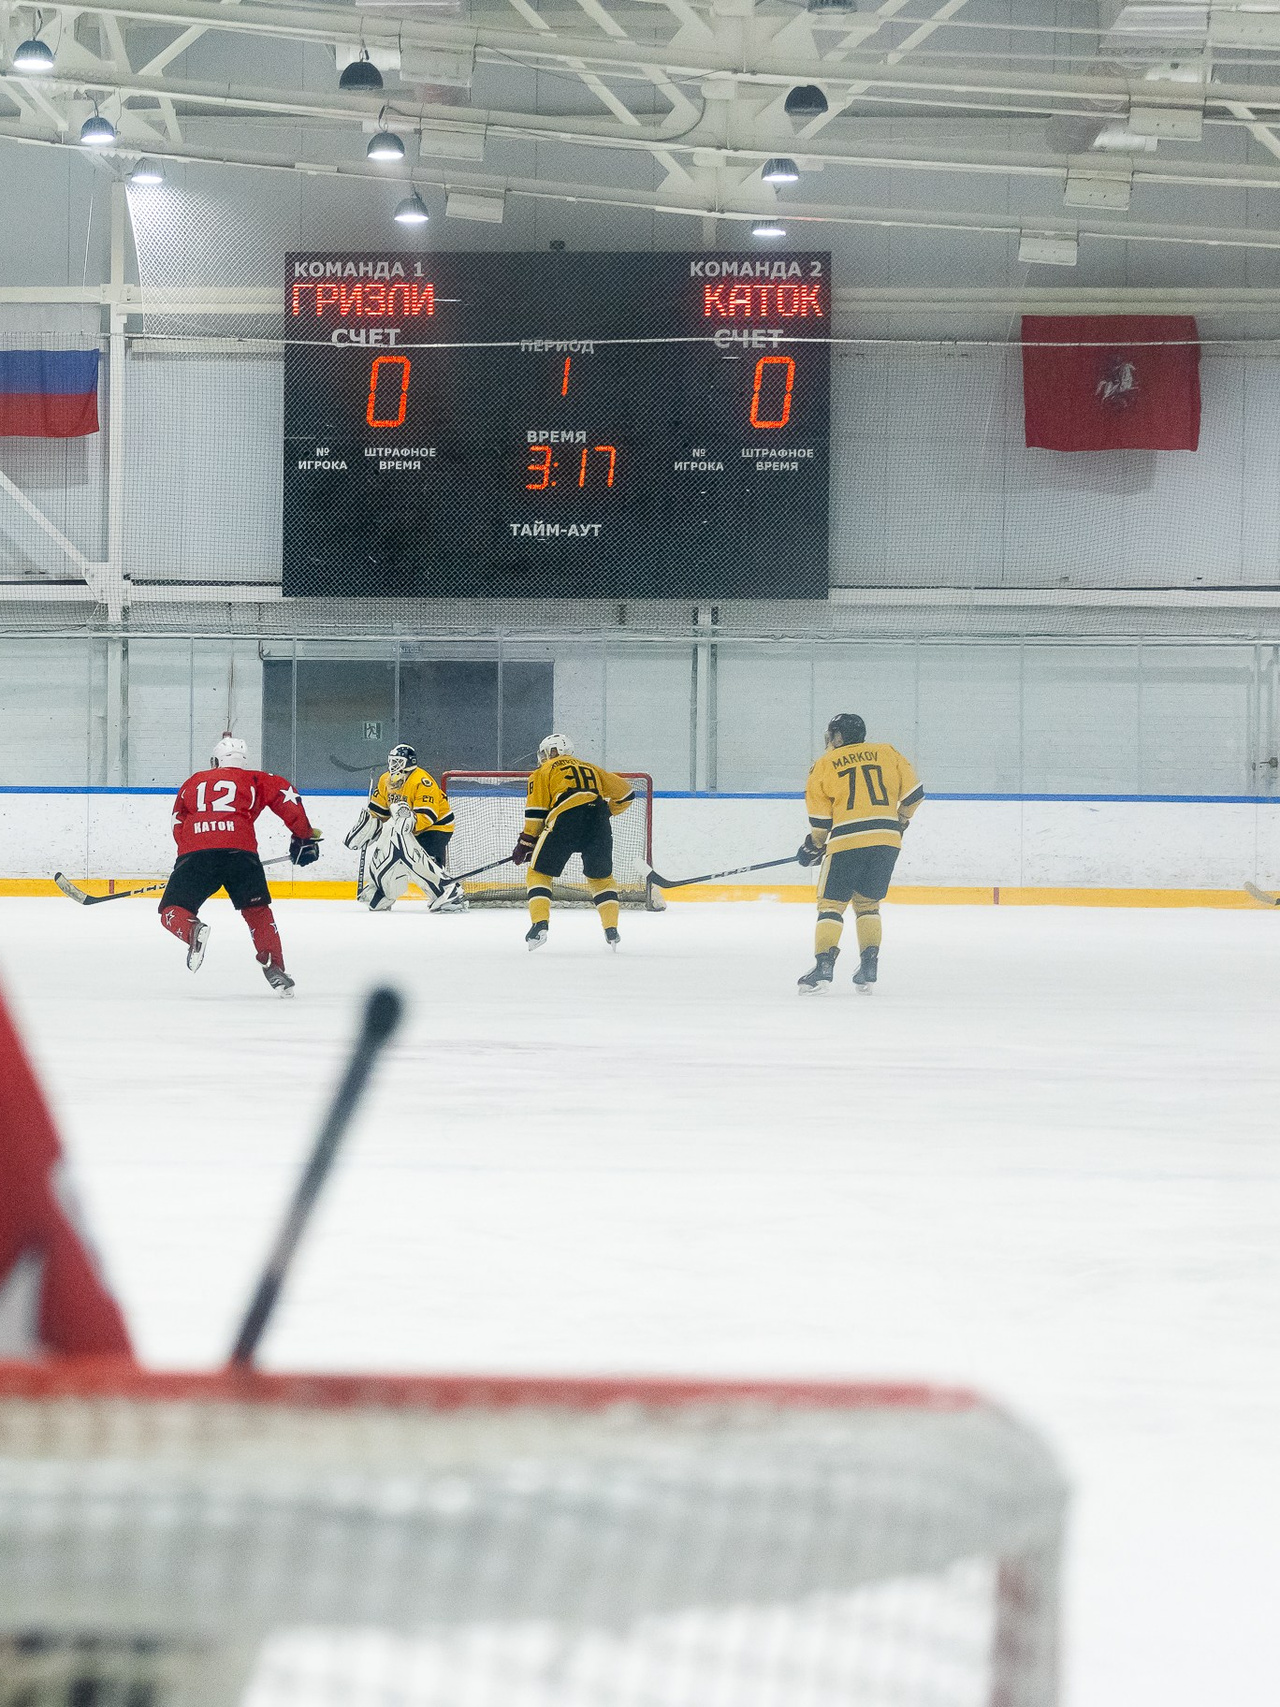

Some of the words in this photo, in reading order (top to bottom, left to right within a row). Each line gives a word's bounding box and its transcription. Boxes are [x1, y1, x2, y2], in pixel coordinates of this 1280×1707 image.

[294, 261, 405, 280] КОМАНДА
[413, 262, 425, 277] 1
[690, 261, 802, 280] КОМАНДА
[810, 261, 822, 277] 2
[292, 282, 435, 317] ГРИЗЛИ
[704, 284, 824, 317] КАТОК
[331, 328, 401, 347] СЧЕТ
[521, 339, 595, 354] ПЕРИОД
[714, 329, 784, 348] СЧЕТ
[561, 356, 571, 396] 1
[366, 355, 411, 428] 0
[749, 356, 796, 428] 0
[527, 430, 587, 443] ВРЕМЯ
[316, 447, 330, 456] №
[364, 447, 436, 457] ШТРАФНОЕ
[692, 448, 706, 457] №
[741, 447, 814, 458] ШТРАФНОЕ
[298, 461, 348, 470] ИГРОКА
[379, 460, 421, 470] ВРЕМЯ
[526, 445, 617, 490] 3:17
[674, 461, 724, 471] ИГРОКА
[756, 461, 799, 471] ВРЕМЯ
[510, 520, 602, 537] ТАЙМ-АУТ
[832, 751, 879, 769] MARKOV
[560, 765, 600, 794] 38
[837, 764, 890, 811] 70
[196, 780, 237, 813] 12
